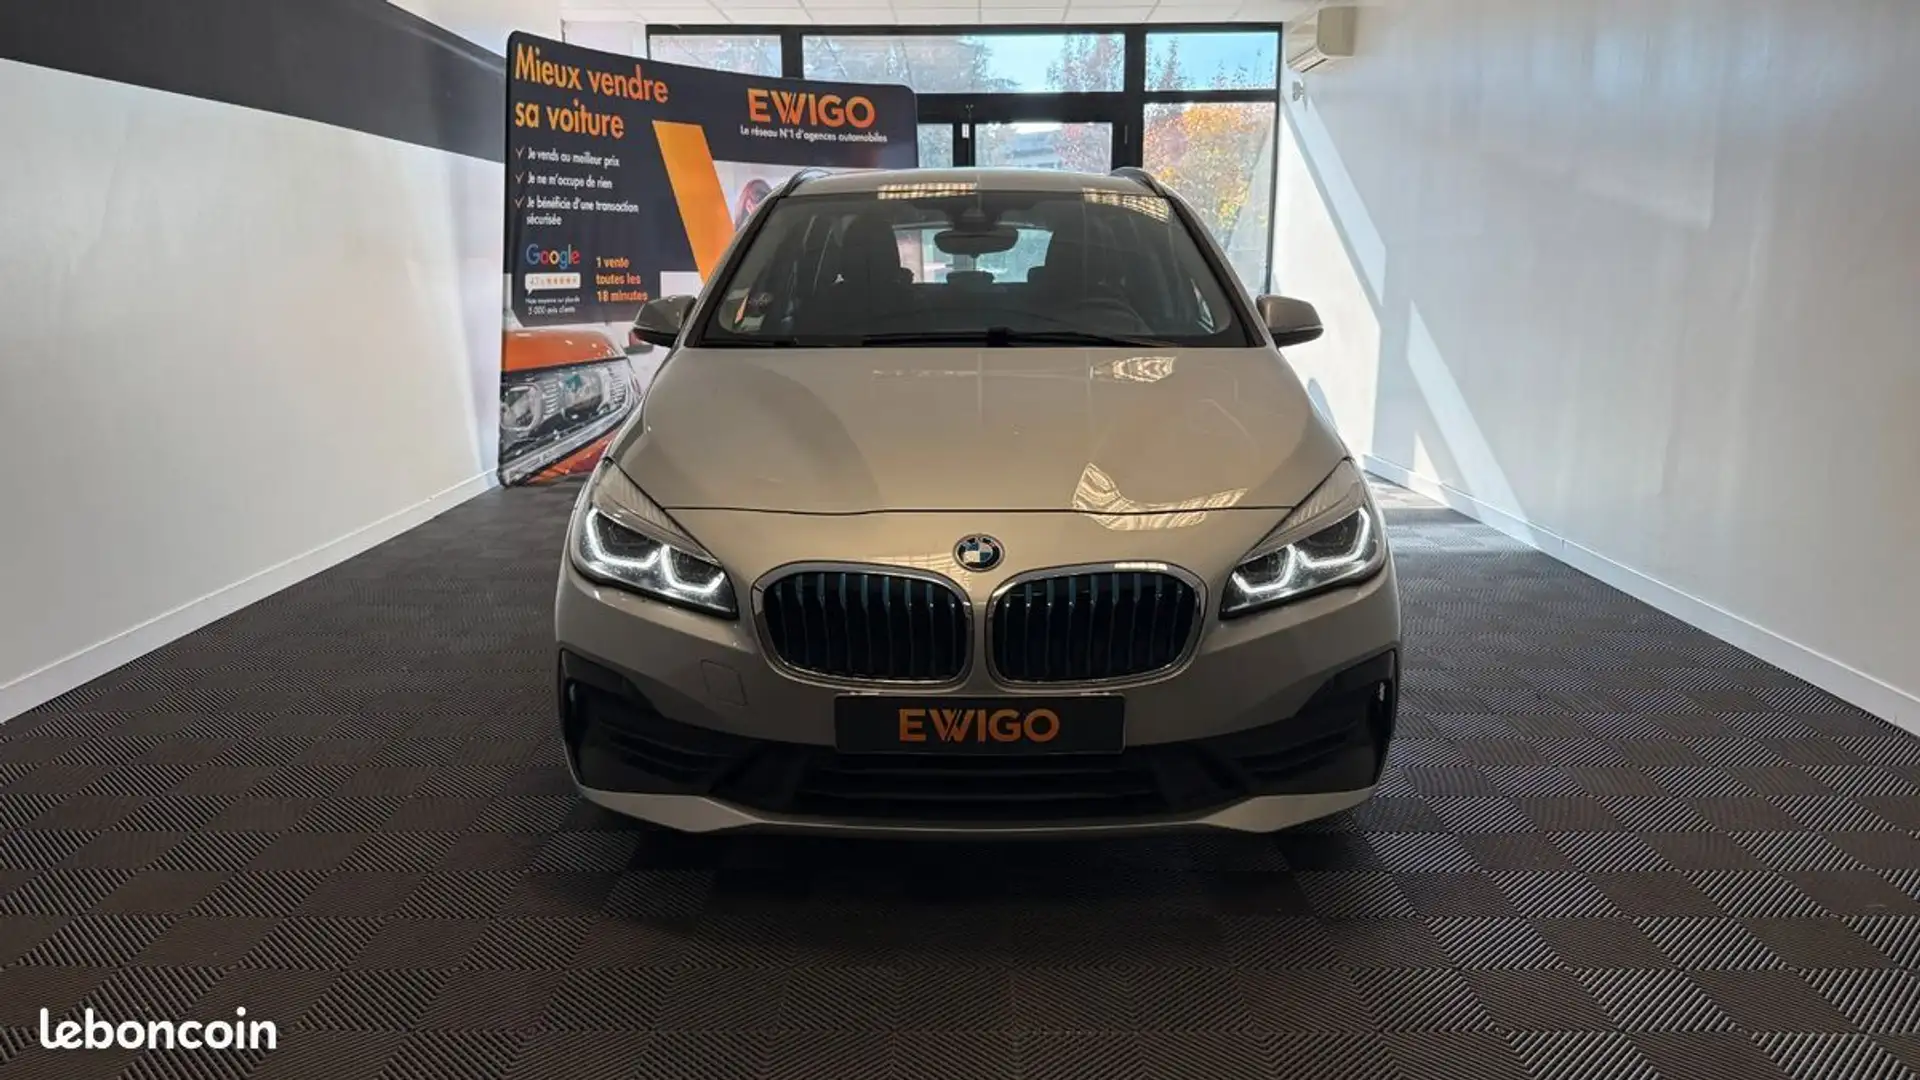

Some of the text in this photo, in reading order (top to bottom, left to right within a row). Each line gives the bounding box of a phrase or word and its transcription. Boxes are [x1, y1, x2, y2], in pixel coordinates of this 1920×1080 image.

[515, 43, 669, 103] Mieux vendre
[747, 88, 876, 128] EWIGO
[515, 98, 625, 139] sa voiture
[740, 125, 750, 136] Le
[751, 126, 778, 138] réseau
[795, 129, 837, 142] d'agences
[838, 131, 888, 143] automobiles
[527, 147, 536, 160] Je
[537, 148, 559, 162] vends
[572, 151, 602, 166] meilleur
[604, 154, 620, 169] prix
[527, 171, 613, 190] Je ne m'occupe de rien
[526, 196, 535, 208] Je
[572, 197, 594, 211] d'une
[595, 200, 639, 213] transaction
[525, 243, 581, 270] Google
[596, 256, 630, 269] 1 vente
[596, 272, 641, 285] toutes les
[596, 291, 648, 302] 18 minutes
[898, 708, 1060, 743] EWIGO
